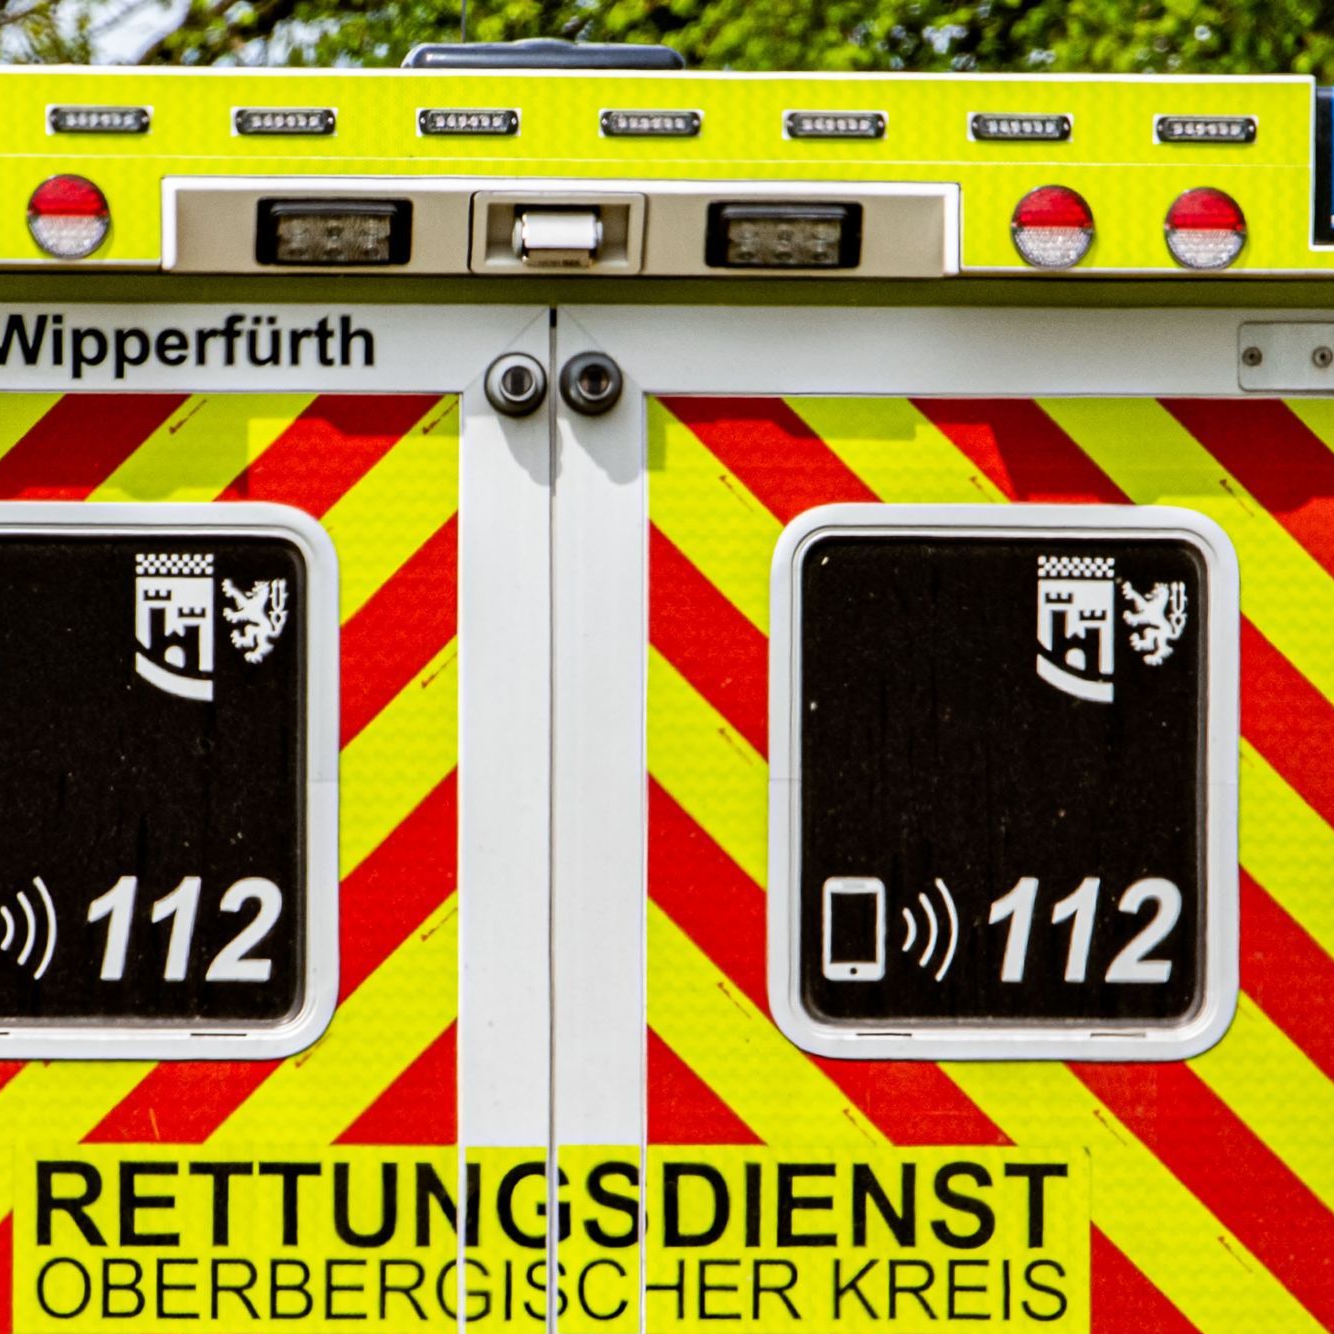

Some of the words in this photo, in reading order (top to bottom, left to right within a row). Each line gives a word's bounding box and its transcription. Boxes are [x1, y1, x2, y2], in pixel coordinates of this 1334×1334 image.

[87, 876, 283, 982] 112
[988, 877, 1182, 983] 112
[35, 1160, 1068, 1249] RETTUNGSDIENST
[36, 1257, 801, 1322] OBERBERGISCHER
[833, 1259, 1068, 1322] KREIS
